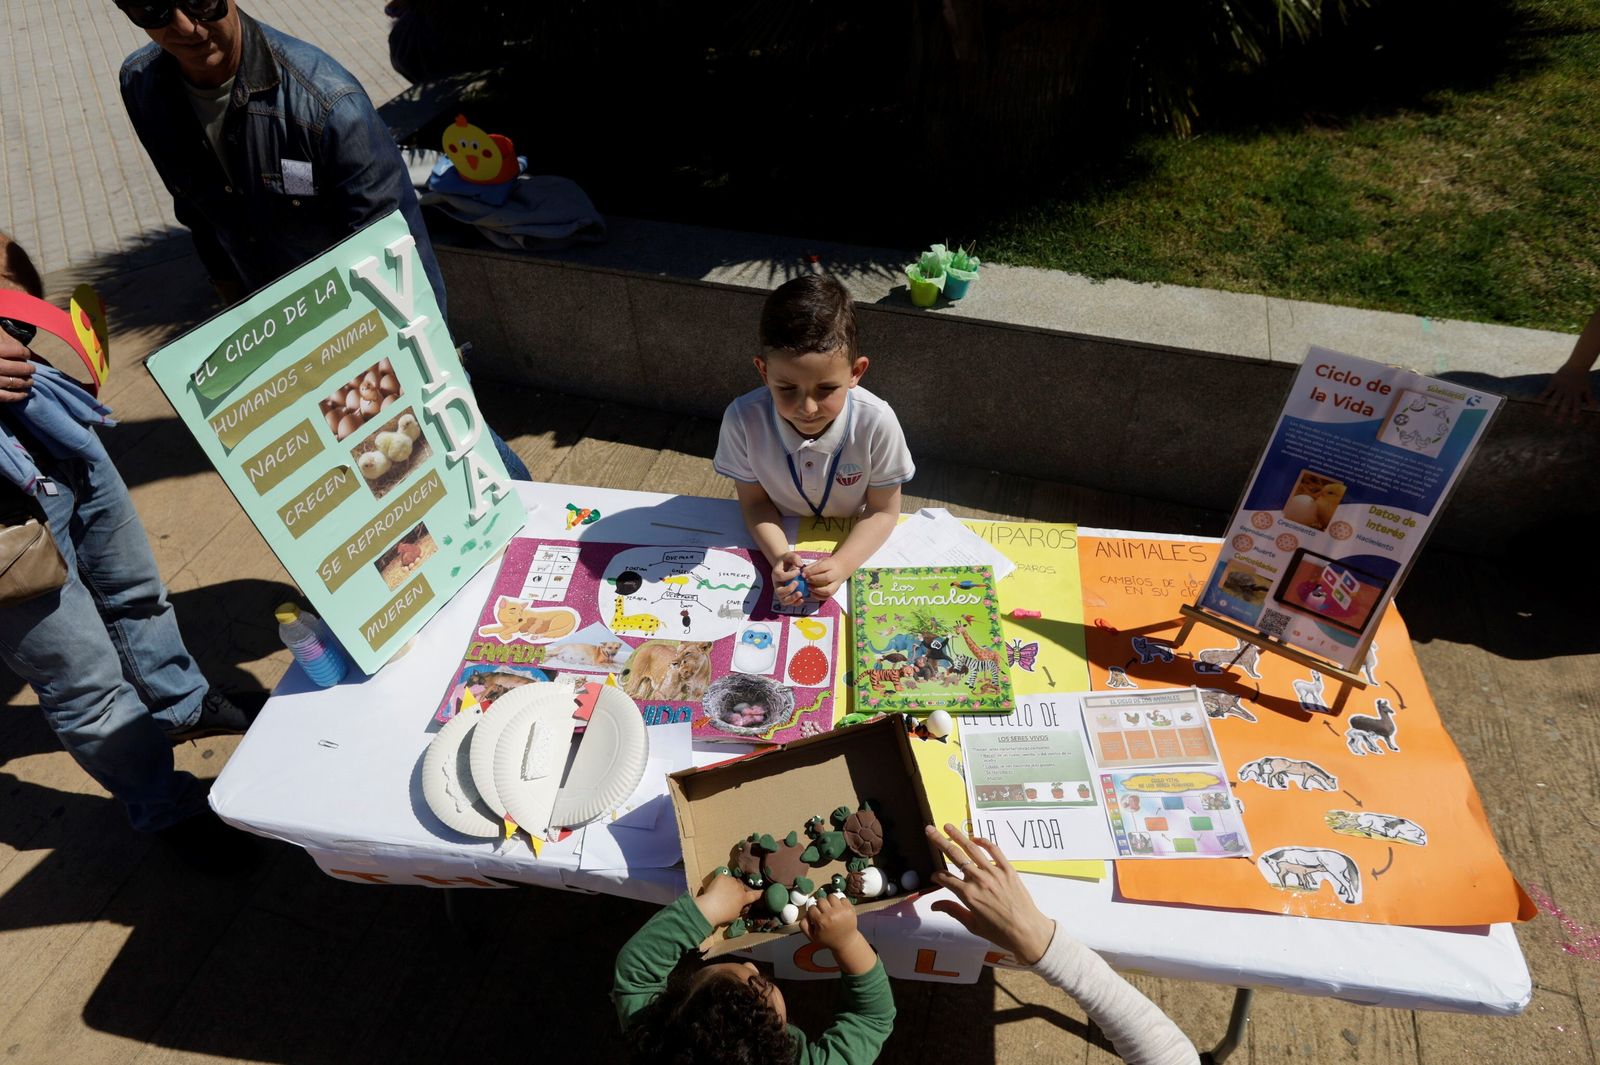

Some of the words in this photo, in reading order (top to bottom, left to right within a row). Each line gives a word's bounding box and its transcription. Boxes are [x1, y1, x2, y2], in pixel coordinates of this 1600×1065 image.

[194, 366, 218, 387] EL
[225, 318, 276, 363] CICLO
[283, 297, 308, 326] DE
[315, 279, 337, 305] LA
[212, 373, 298, 438] HUMANOS
[321, 318, 377, 366] ANIMAL
[350, 234, 515, 521] VIDA
[1315, 364, 1362, 386] Ciclo
[1366, 380, 1392, 395] de
[1309, 387, 1327, 402] la
[1333, 393, 1374, 417] Vida
[248, 429, 310, 484] NACEN
[284, 473, 347, 528] CRECEN
[321, 558, 342, 583] SE
[347, 476, 440, 560] REPRODUCEN
[1276, 519, 1316, 537] Crecimiento
[1368, 506, 1401, 523] Datos
[1402, 513, 1416, 528] de
[964, 522, 1077, 549] VÍPAROS
[1356, 534, 1394, 551] Nacimiento
[1095, 539, 1207, 562] ANIMALES
[1015, 561, 1056, 574] PAROS
[891, 582, 915, 592] Los
[1100, 575, 1153, 587] CAMBIOS
[1163, 579, 1176, 588] DE
[1124, 586, 1143, 595] EN
[1152, 587, 1169, 597] SU
[868, 588, 981, 607] Animales
[366, 582, 424, 642] MUEREN
[465, 641, 546, 664] CAMADA
[1040, 702, 1059, 727] DE
[1006, 818, 1064, 850] VIDA
